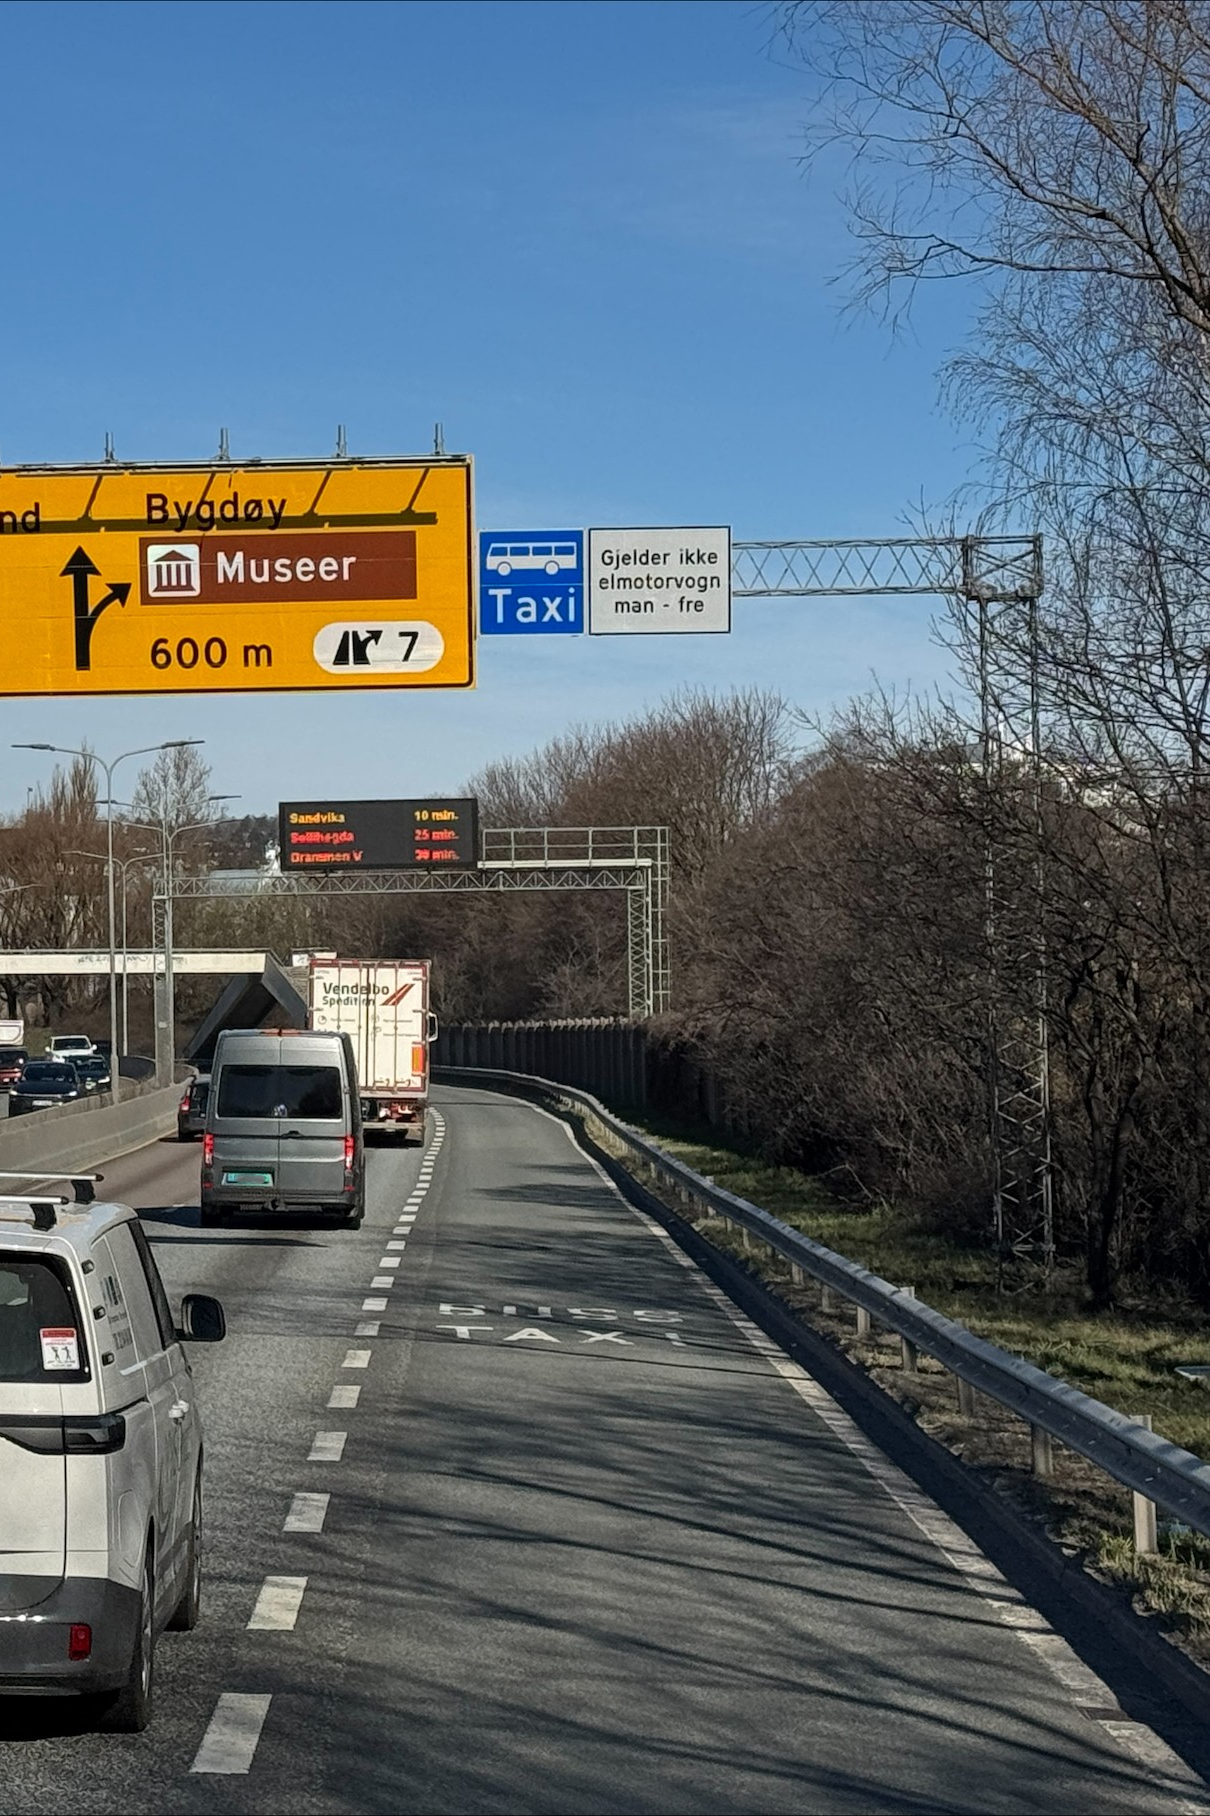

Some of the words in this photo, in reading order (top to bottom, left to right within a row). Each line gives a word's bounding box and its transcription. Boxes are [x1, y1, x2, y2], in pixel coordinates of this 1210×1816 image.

[146, 491, 288, 532] Bygdøy
[217, 550, 357, 584] Museer
[601, 548, 671, 571] Gjelder
[679, 548, 718, 566] ikke
[598, 572, 721, 593] elmotorvogn
[488, 587, 576, 624] Taxi
[614, 600, 655, 614] man
[678, 596, 705, 613] fre
[150, 637, 228, 671] 600
[243, 643, 273, 668] m
[397, 631, 420, 663] 7
[289, 811, 346, 824] Sandvika
[414, 810, 429, 821] 10
[290, 851, 351, 863] Drammen
[322, 982, 390, 996] Vendelbo
